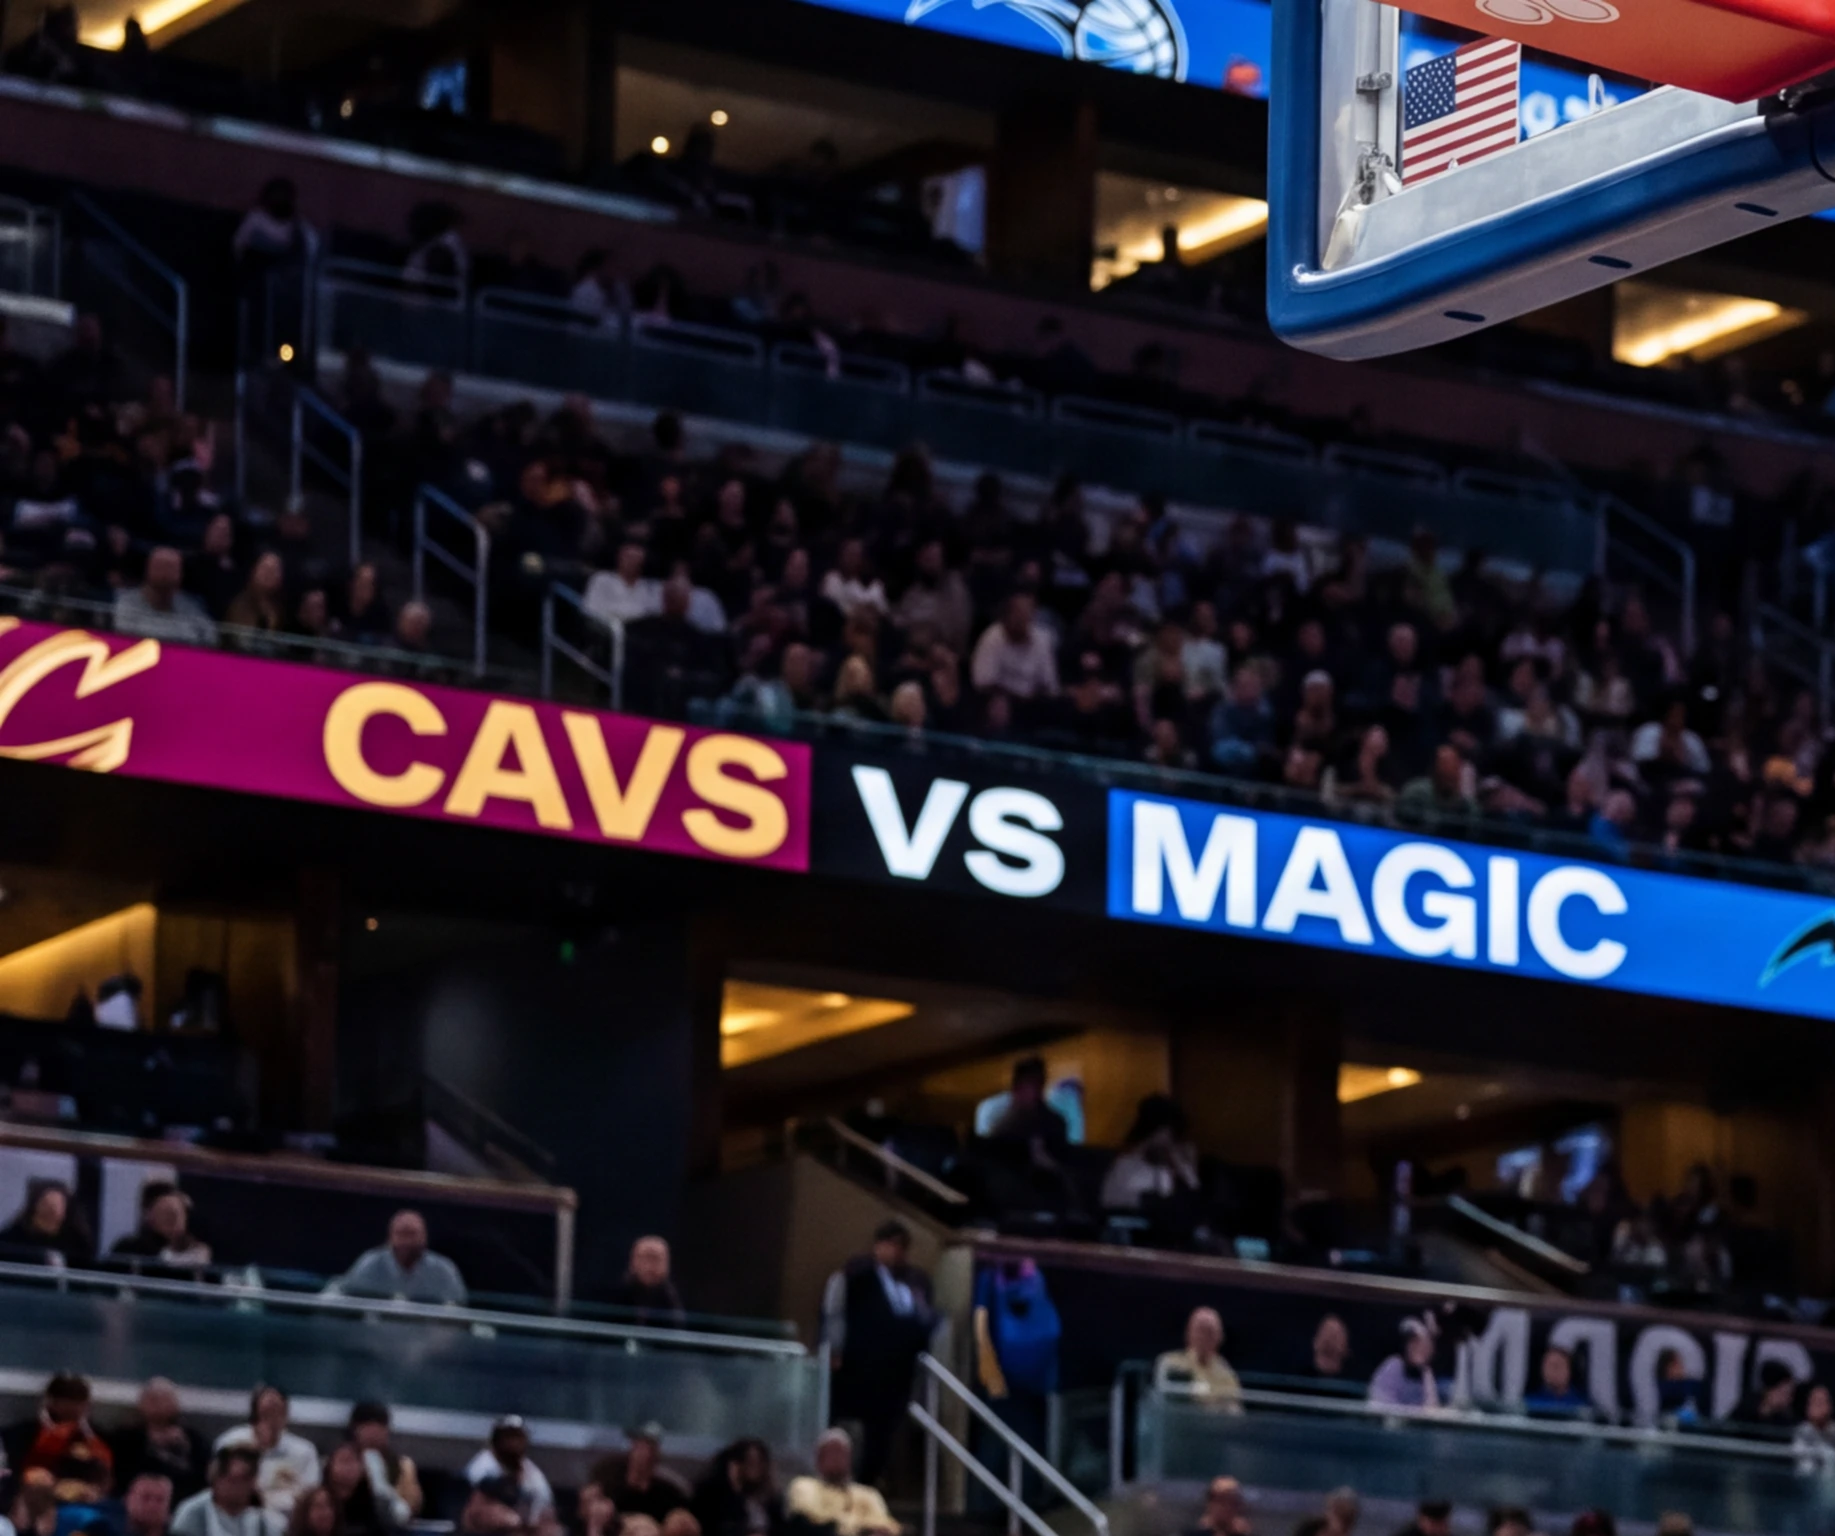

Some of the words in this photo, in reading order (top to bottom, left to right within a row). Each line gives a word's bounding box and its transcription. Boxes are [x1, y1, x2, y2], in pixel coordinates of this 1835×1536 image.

[323, 682, 789, 859] CAVS
[852, 764, 1066, 897] VS
[1131, 798, 1630, 980] MAGIC
